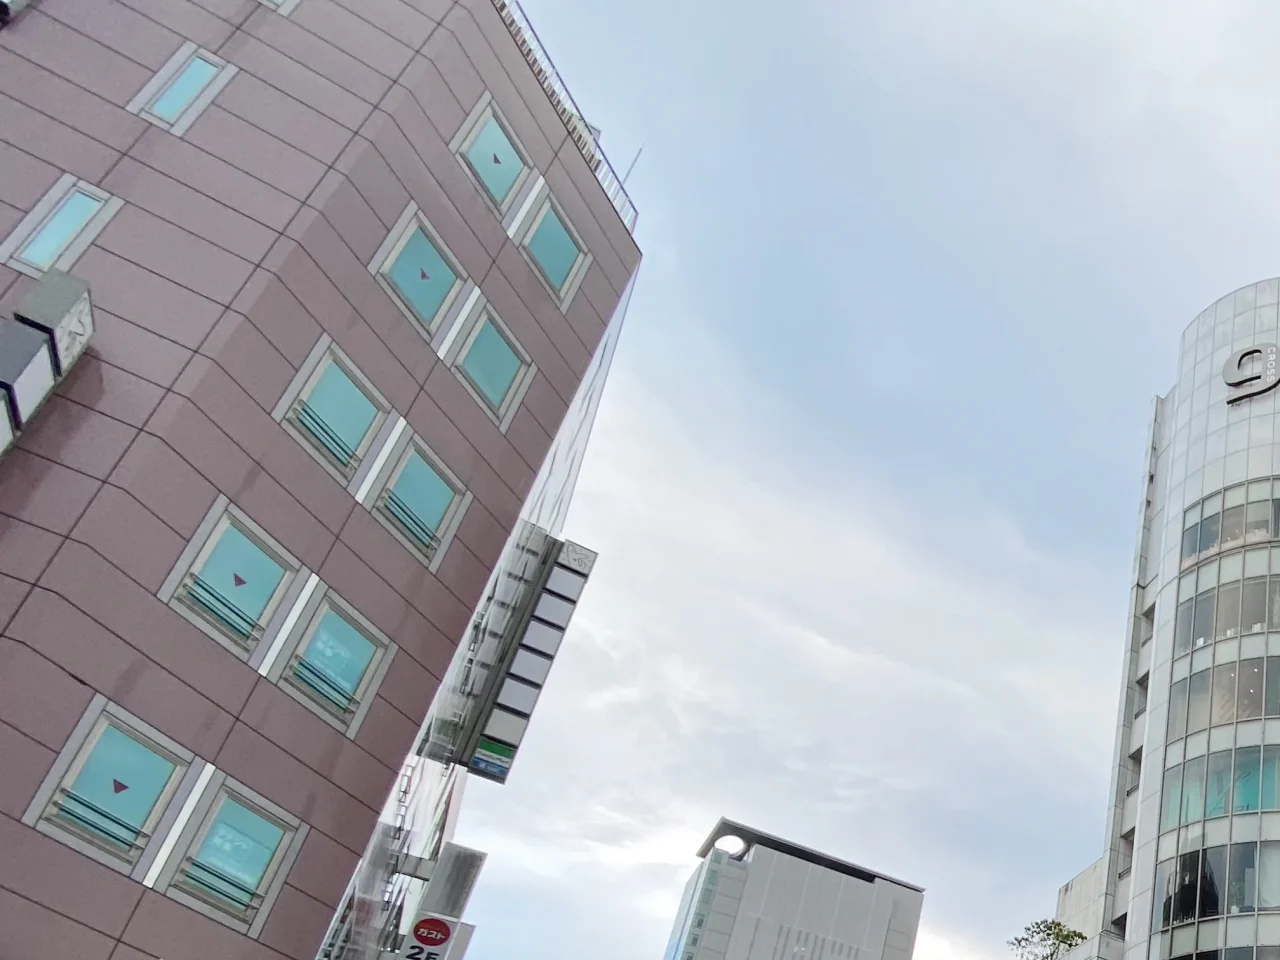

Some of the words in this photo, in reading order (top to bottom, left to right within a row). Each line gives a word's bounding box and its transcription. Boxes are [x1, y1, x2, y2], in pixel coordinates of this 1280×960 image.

[1267, 346, 1276, 383] CROSS
[417, 928, 446, 940] ガスト
